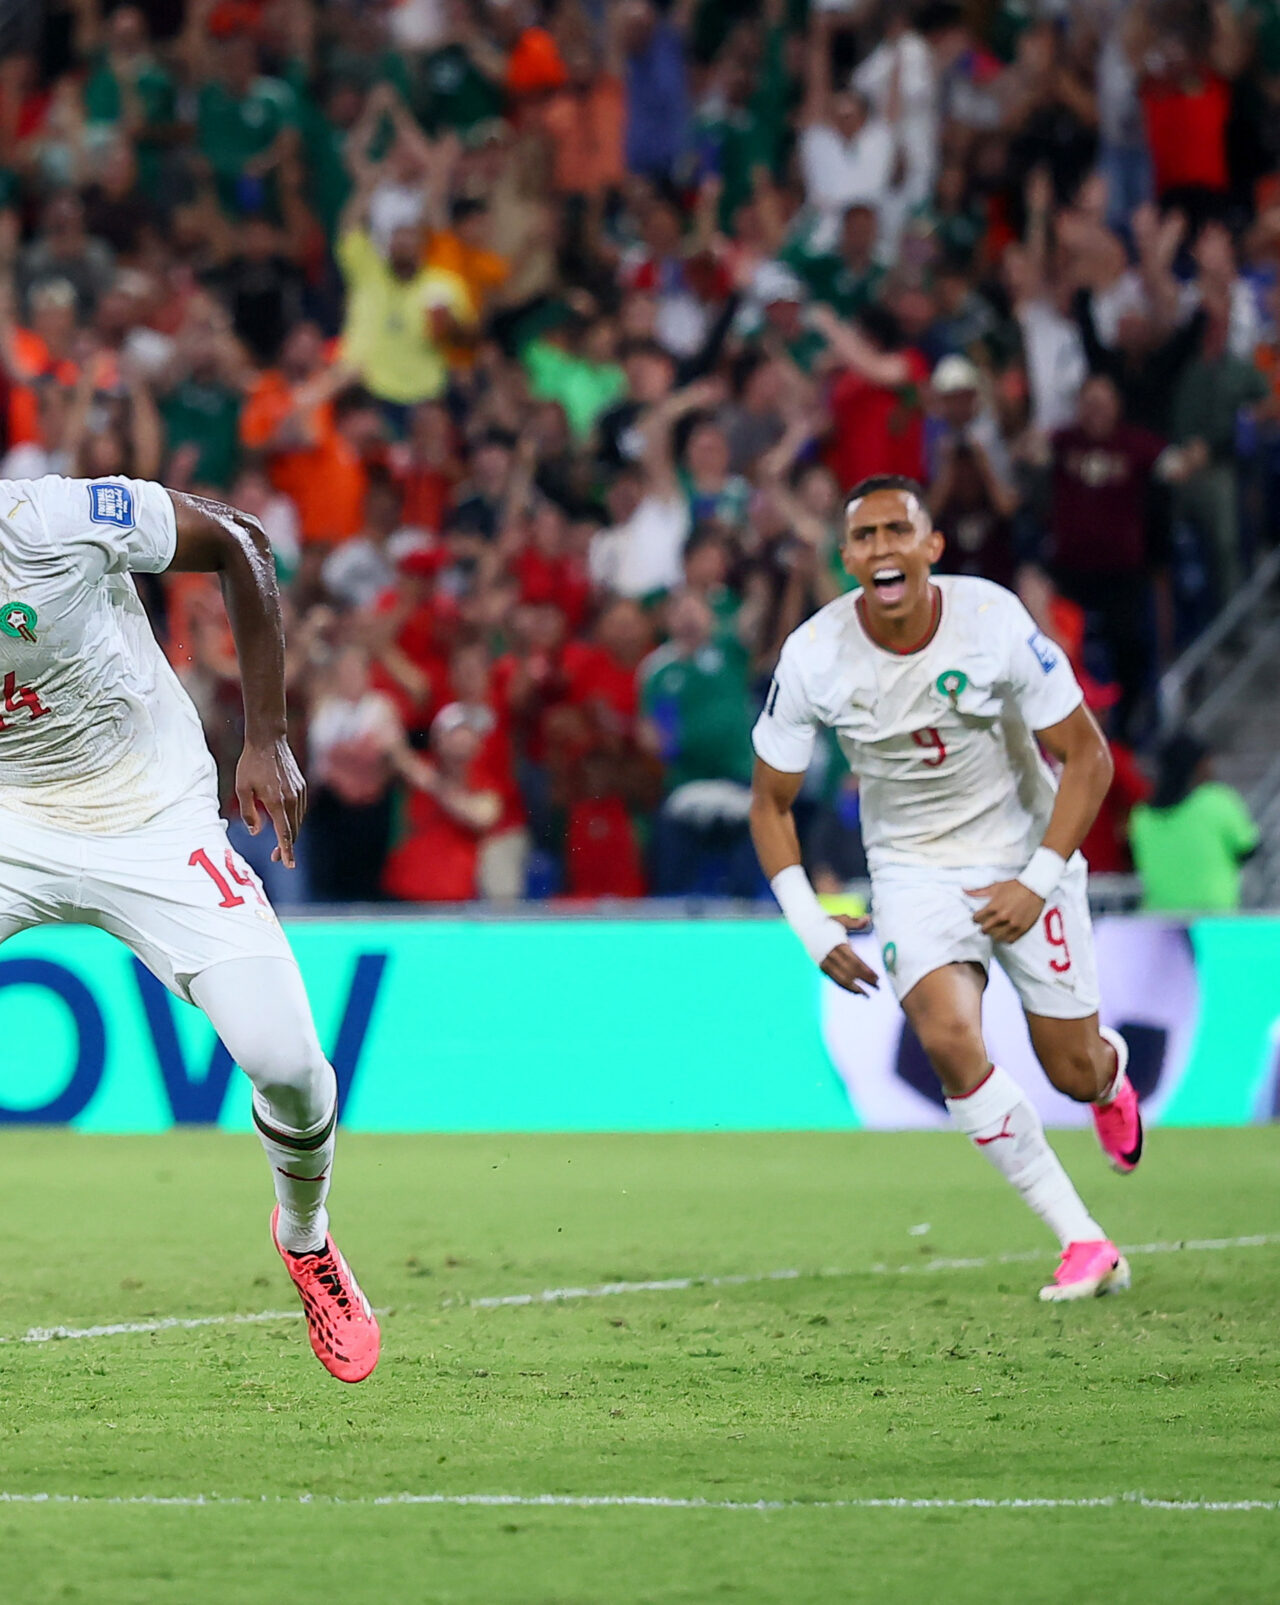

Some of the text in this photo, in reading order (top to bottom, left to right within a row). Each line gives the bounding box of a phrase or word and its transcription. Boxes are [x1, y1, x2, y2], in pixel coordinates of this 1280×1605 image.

[105, 488, 116, 517] UNITES
[911, 727, 946, 767] 9
[188, 848, 268, 908] 14
[1044, 908, 1071, 973] 9
